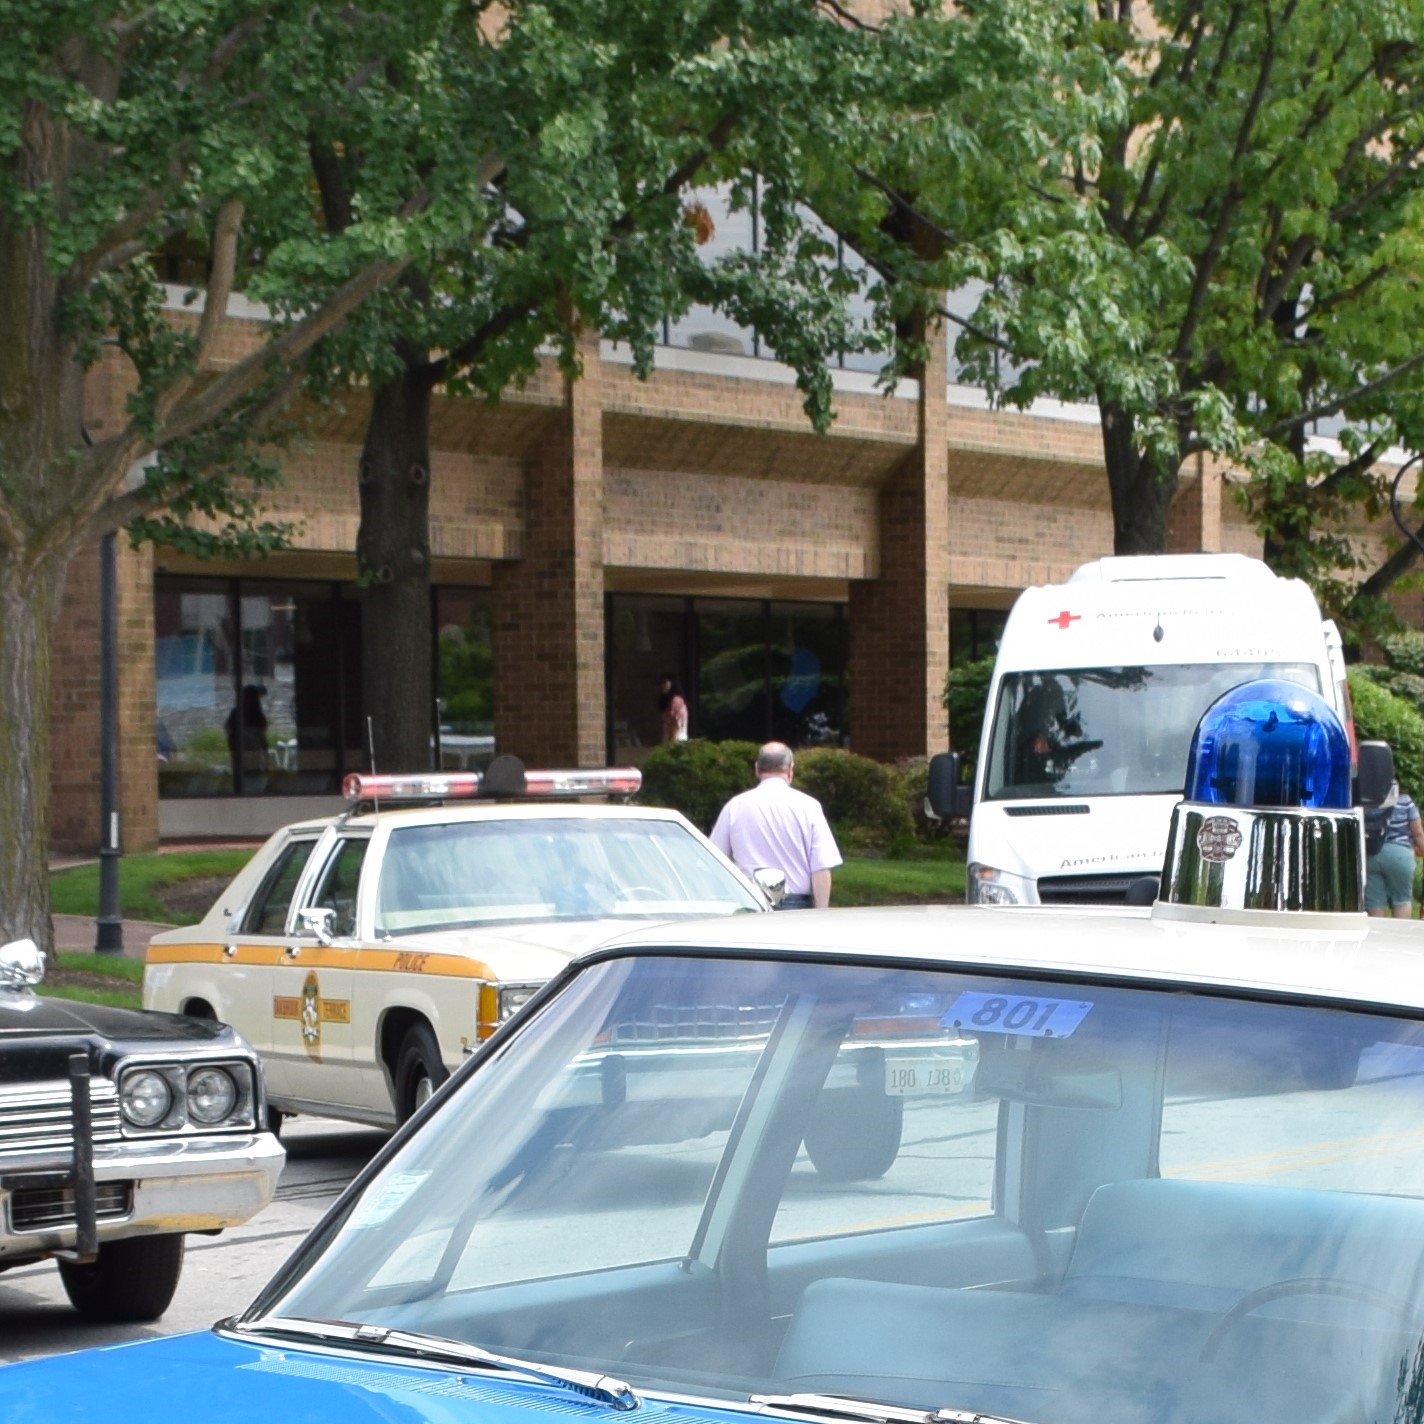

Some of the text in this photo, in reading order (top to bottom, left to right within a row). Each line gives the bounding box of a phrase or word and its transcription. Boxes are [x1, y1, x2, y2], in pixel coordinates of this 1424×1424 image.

[1060, 850, 1147, 869] American
[393, 952, 430, 971] POLICE
[972, 998, 1060, 1030] 801
[890, 1067, 951, 1089] 180 138
